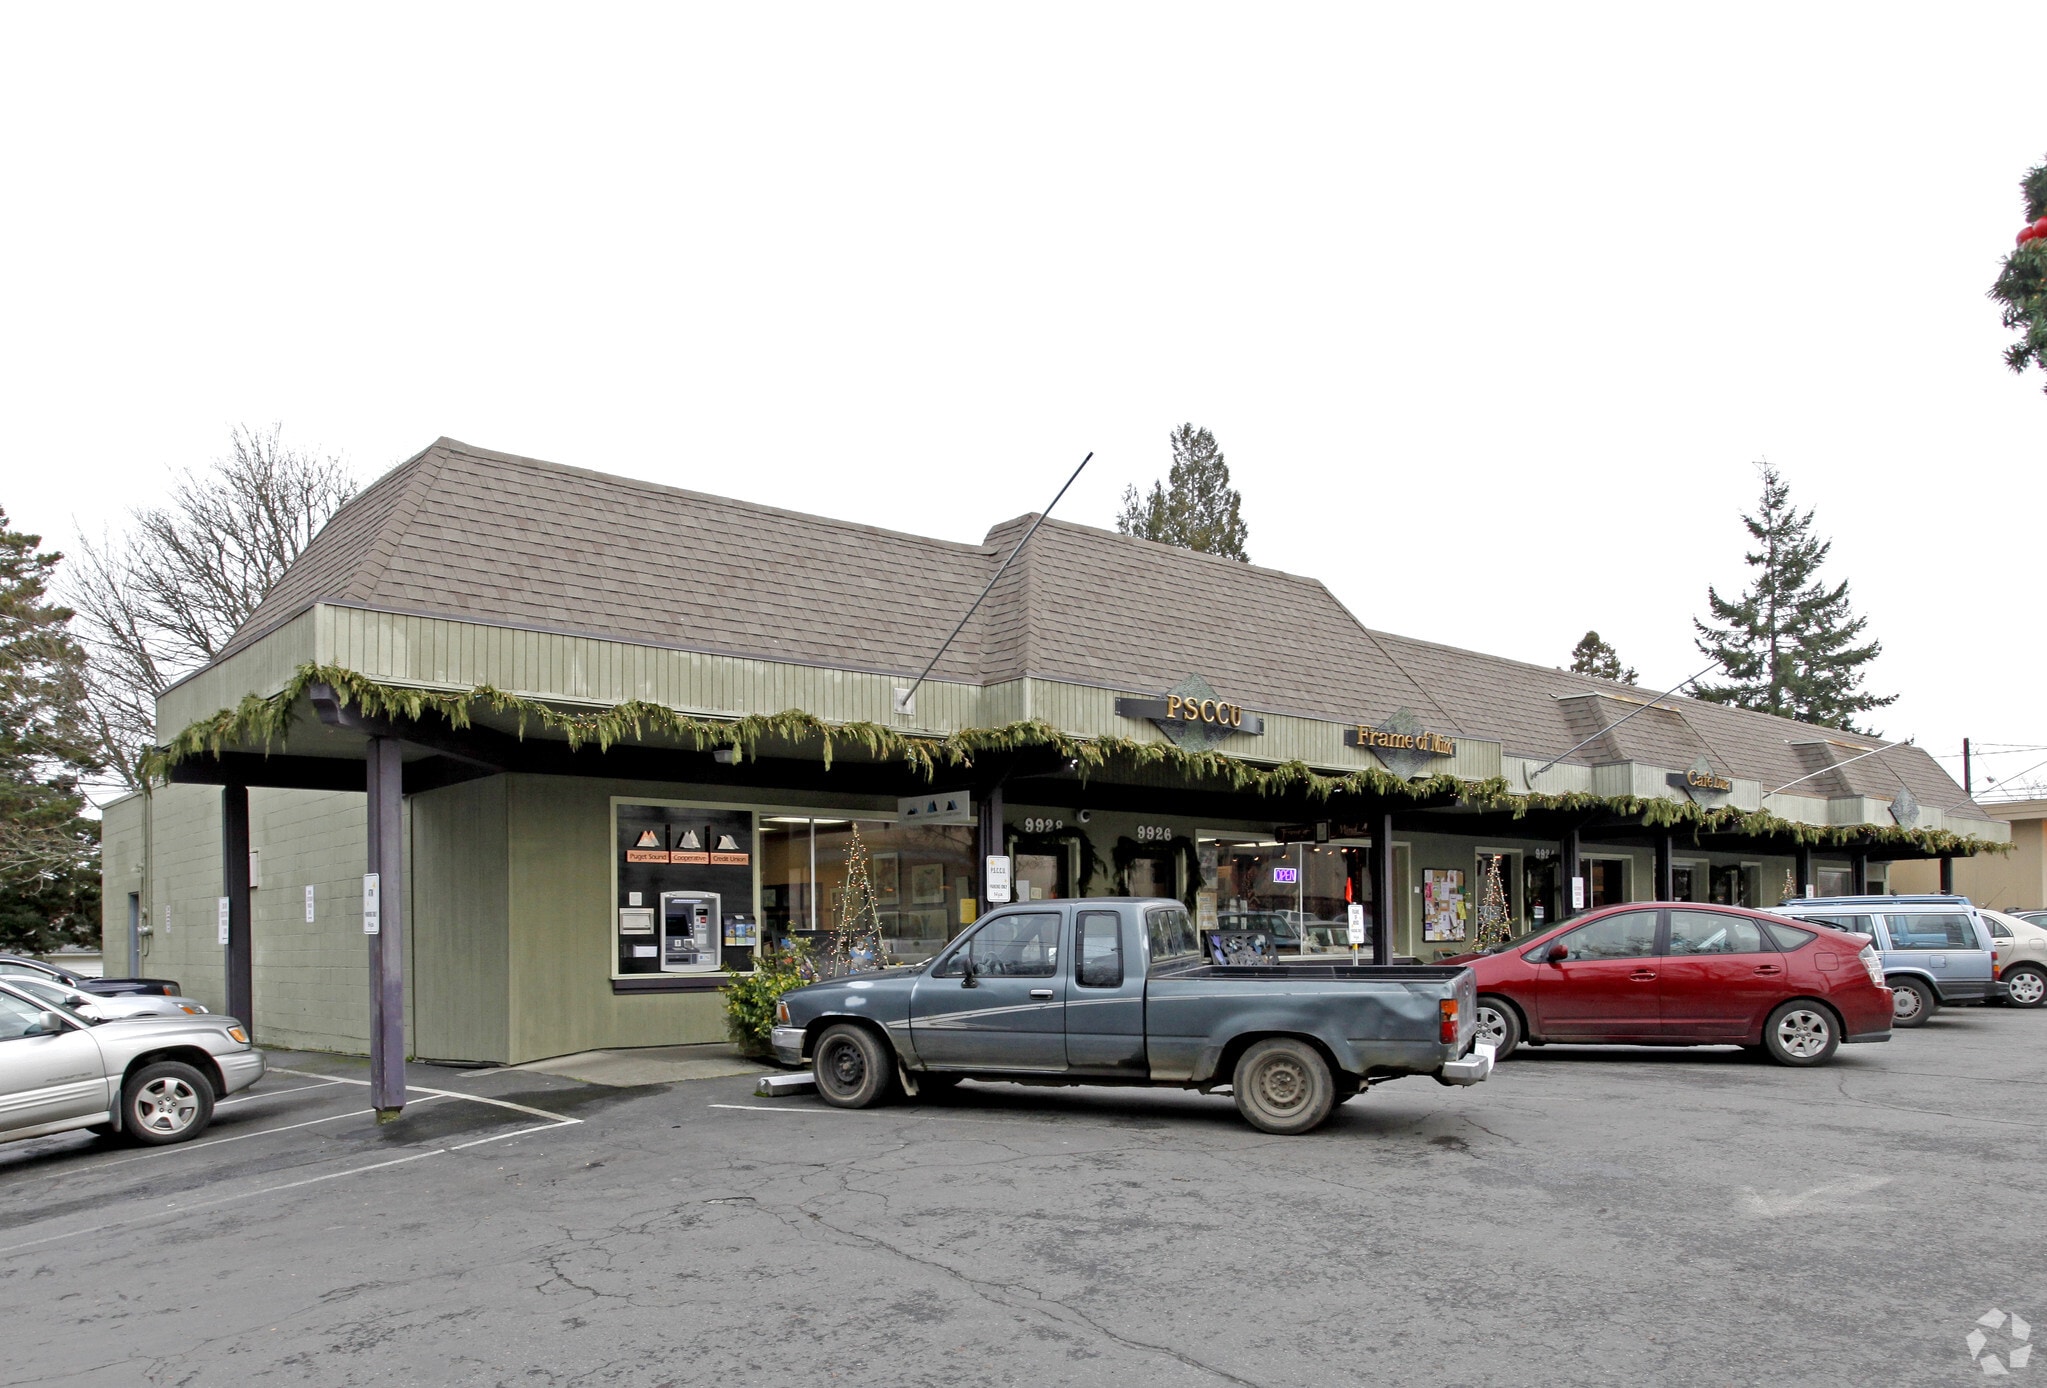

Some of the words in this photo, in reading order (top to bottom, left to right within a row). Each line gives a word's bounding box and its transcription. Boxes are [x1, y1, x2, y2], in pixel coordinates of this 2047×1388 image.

[1166, 694, 1242, 727] PSCCU
[1357, 724, 1413, 749] Frame
[1415, 731, 1431, 751] of
[1430, 732, 1453, 755] Mind
[1687, 770, 1713, 788] Cafe
[1025, 817, 1063, 833] 9928
[1137, 825, 1172, 841] 9926
[630, 853, 647, 862] Puget
[648, 853, 667, 861] Sound
[673, 854, 707, 863] Cooperative
[1276, 869, 1296, 881] OPEN
